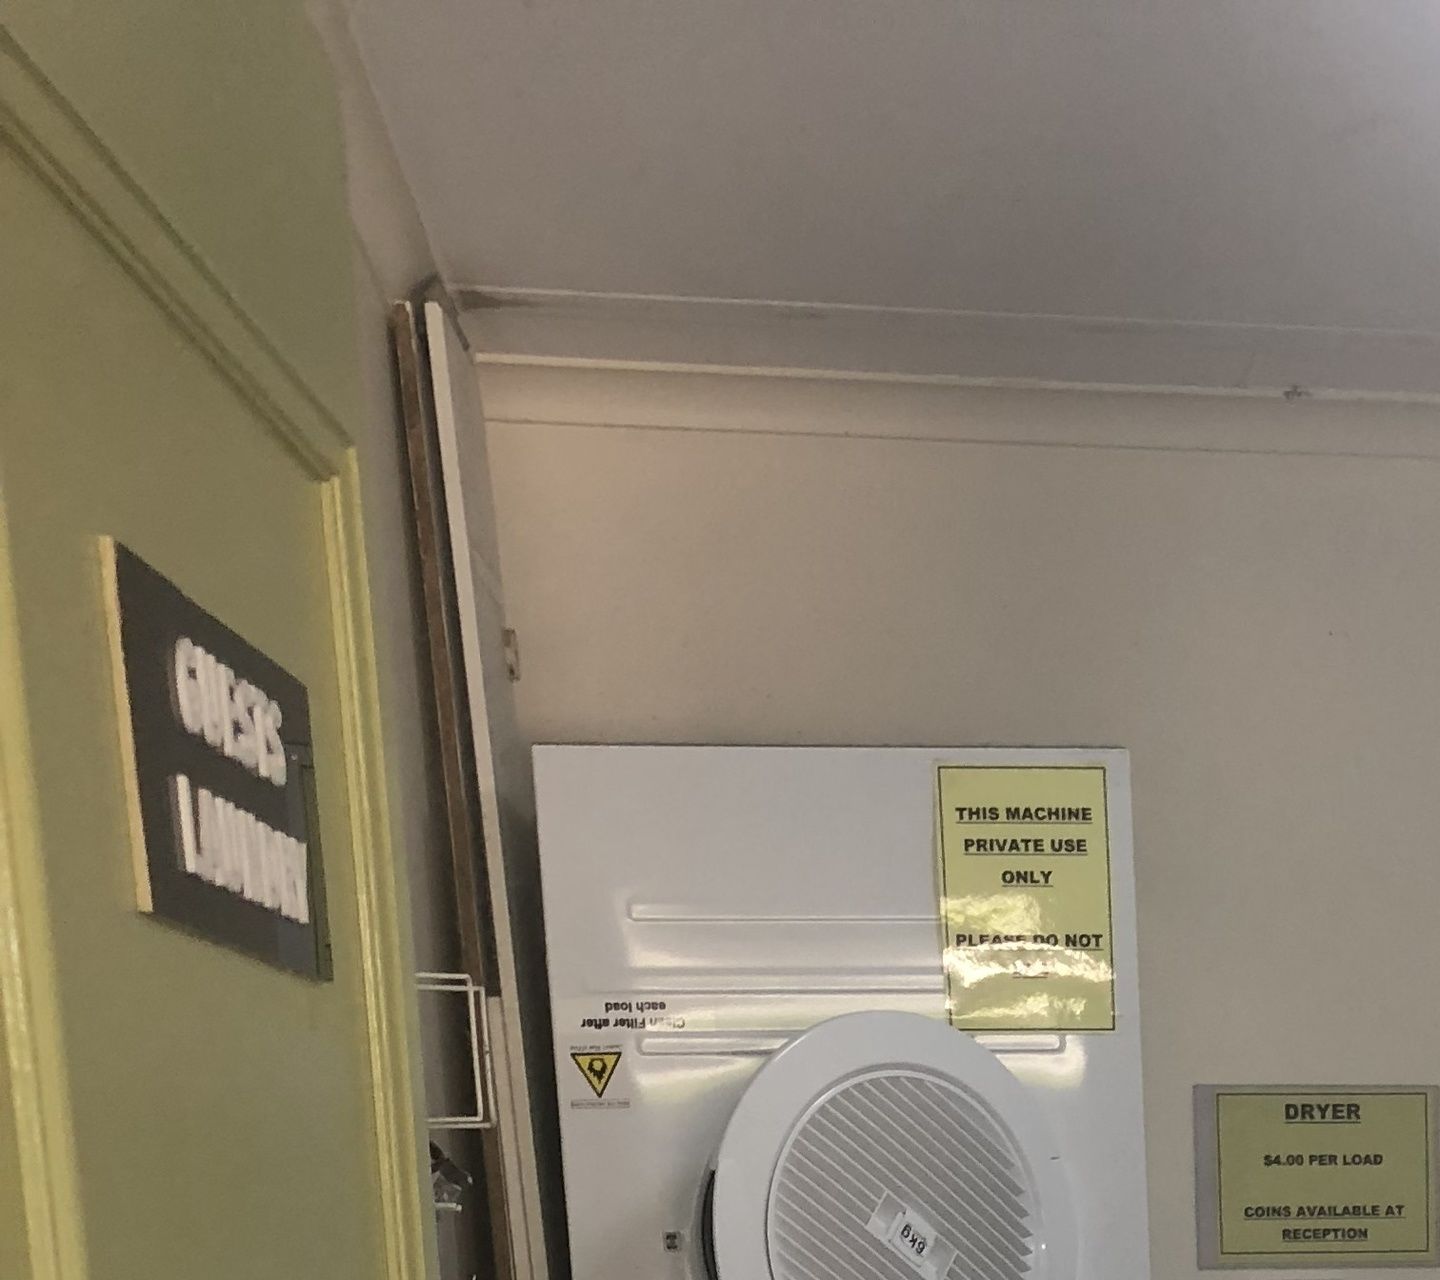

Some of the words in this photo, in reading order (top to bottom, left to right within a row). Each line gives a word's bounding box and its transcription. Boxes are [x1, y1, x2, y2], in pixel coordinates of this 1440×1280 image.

[955, 806, 1000, 821] THIS
[1005, 806, 1093, 822] MACHINE
[963, 838, 1045, 853] PRIVATE
[1050, 838, 1088, 853] USE
[1001, 870, 1054, 885] ONLY
[1032, 933, 1059, 947] DO
[1064, 933, 1103, 948] NOT
[604, 1001, 633, 1013] load
[635, 1001, 667, 1013] each
[580, 1017, 609, 1030] after
[613, 1017, 646, 1029] Filter
[1284, 1103, 1361, 1121] DRYER
[1263, 1154, 1304, 1167] $4.00
[1308, 1154, 1339, 1167] PER
[1342, 1154, 1383, 1167] LOAD
[1243, 1205, 1292, 1218] COINS
[1295, 1205, 1380, 1218] AVAILABLE
[1384, 1204, 1405, 1217] AT
[901, 1223, 927, 1255] 6kg
[1281, 1228, 1369, 1241] RECEPTION
